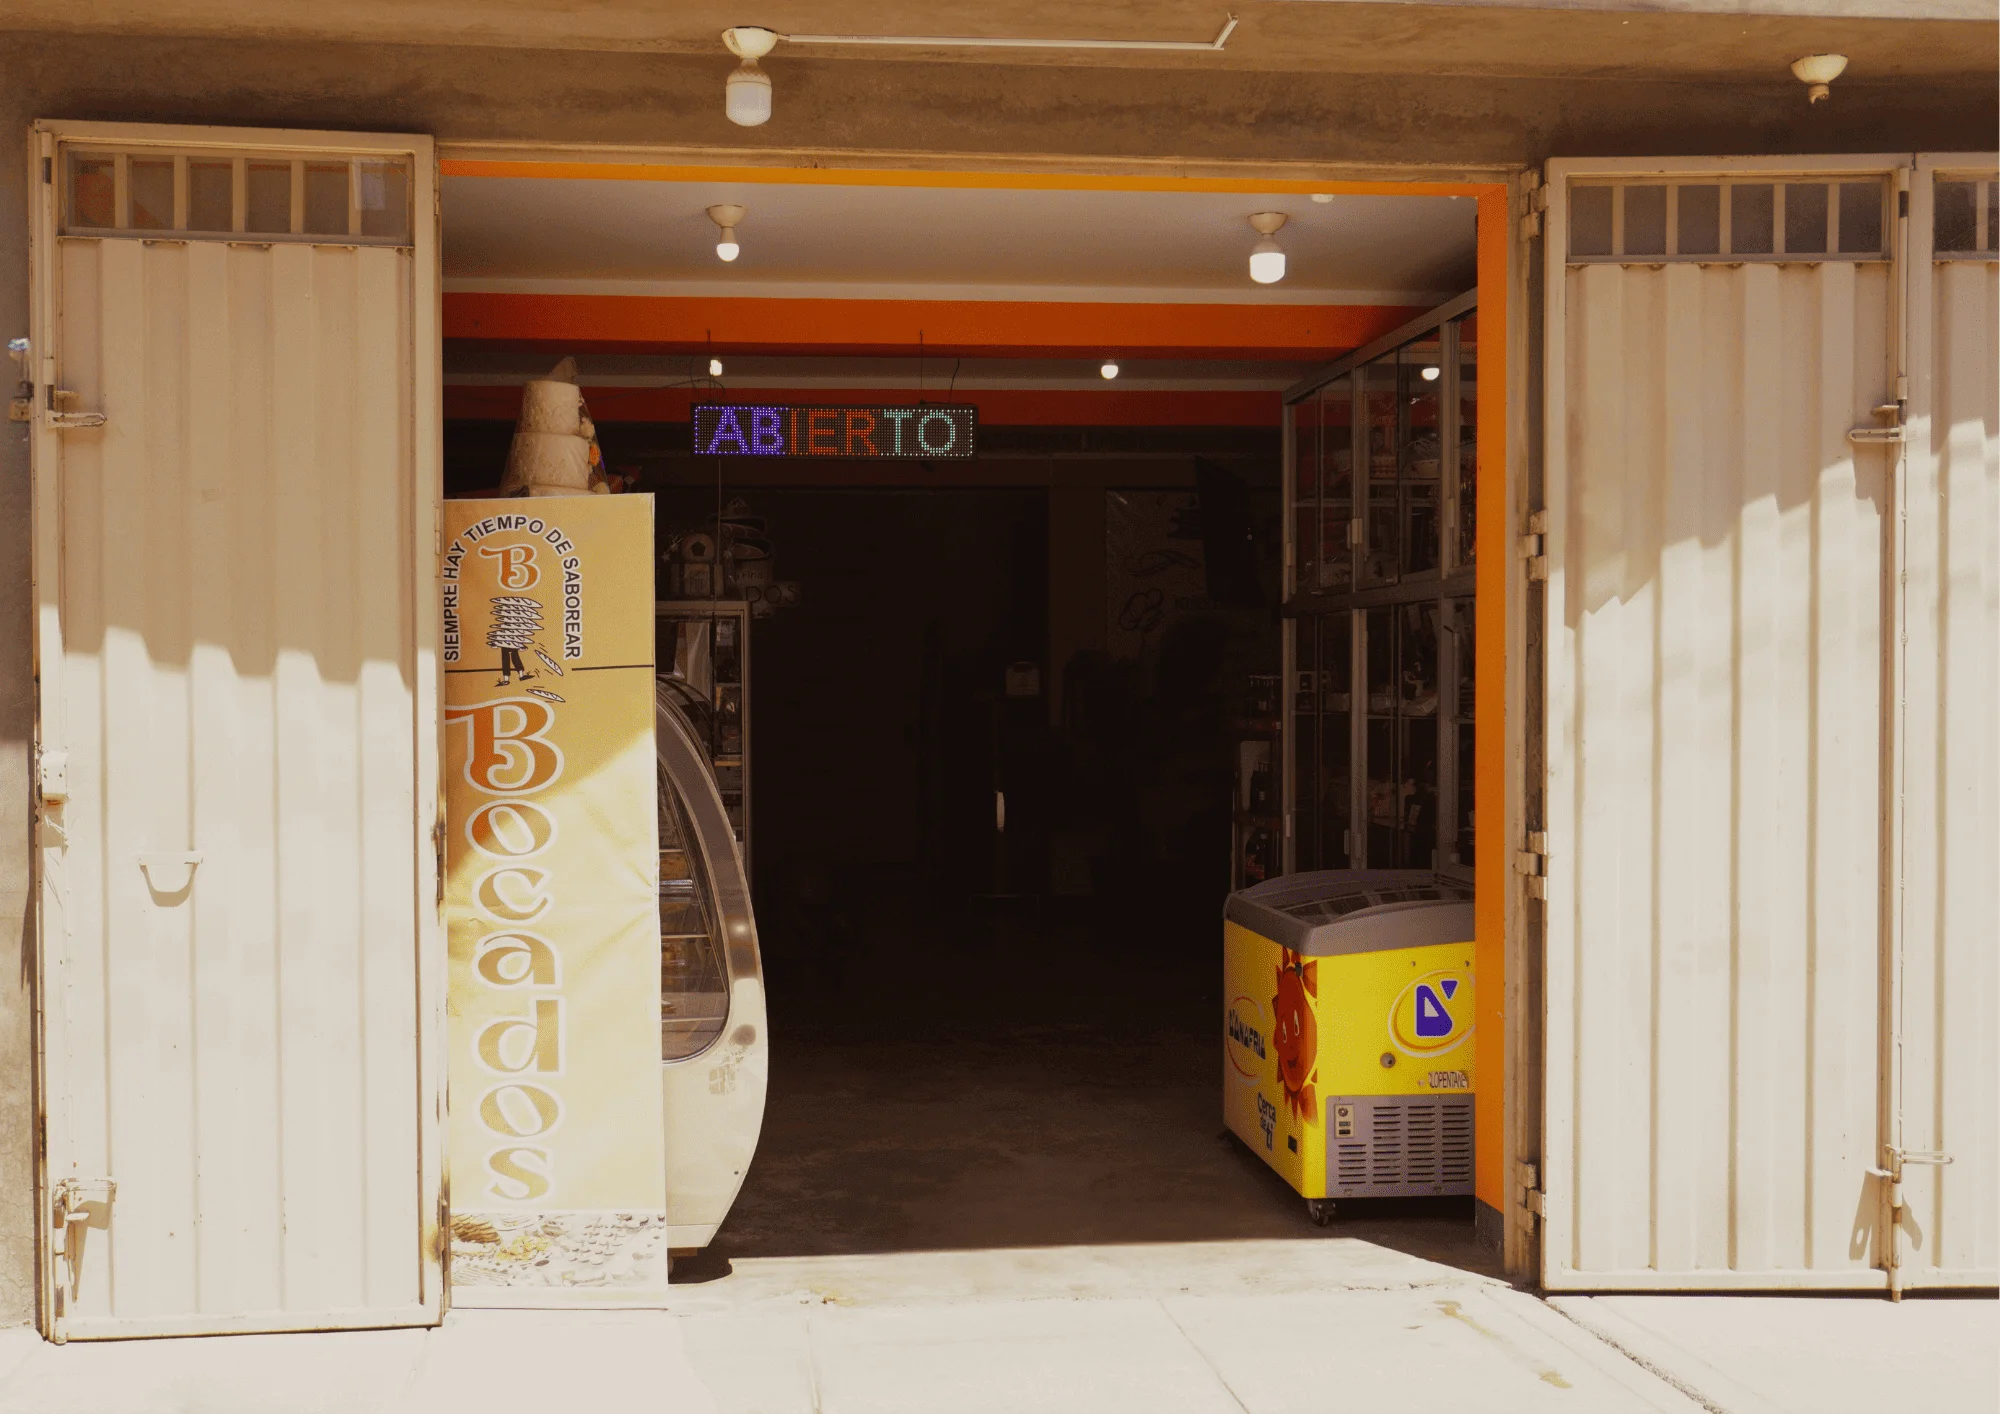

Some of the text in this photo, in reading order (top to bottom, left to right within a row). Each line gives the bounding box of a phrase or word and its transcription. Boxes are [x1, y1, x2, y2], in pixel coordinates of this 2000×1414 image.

[707, 406, 956, 455] ABIERTO
[444, 515, 581, 661] SIEMPRE HAY TIEMPO DE SABOREAR
[444, 697, 566, 1202] Bocados
[1257, 1091, 1277, 1124] Cerca
